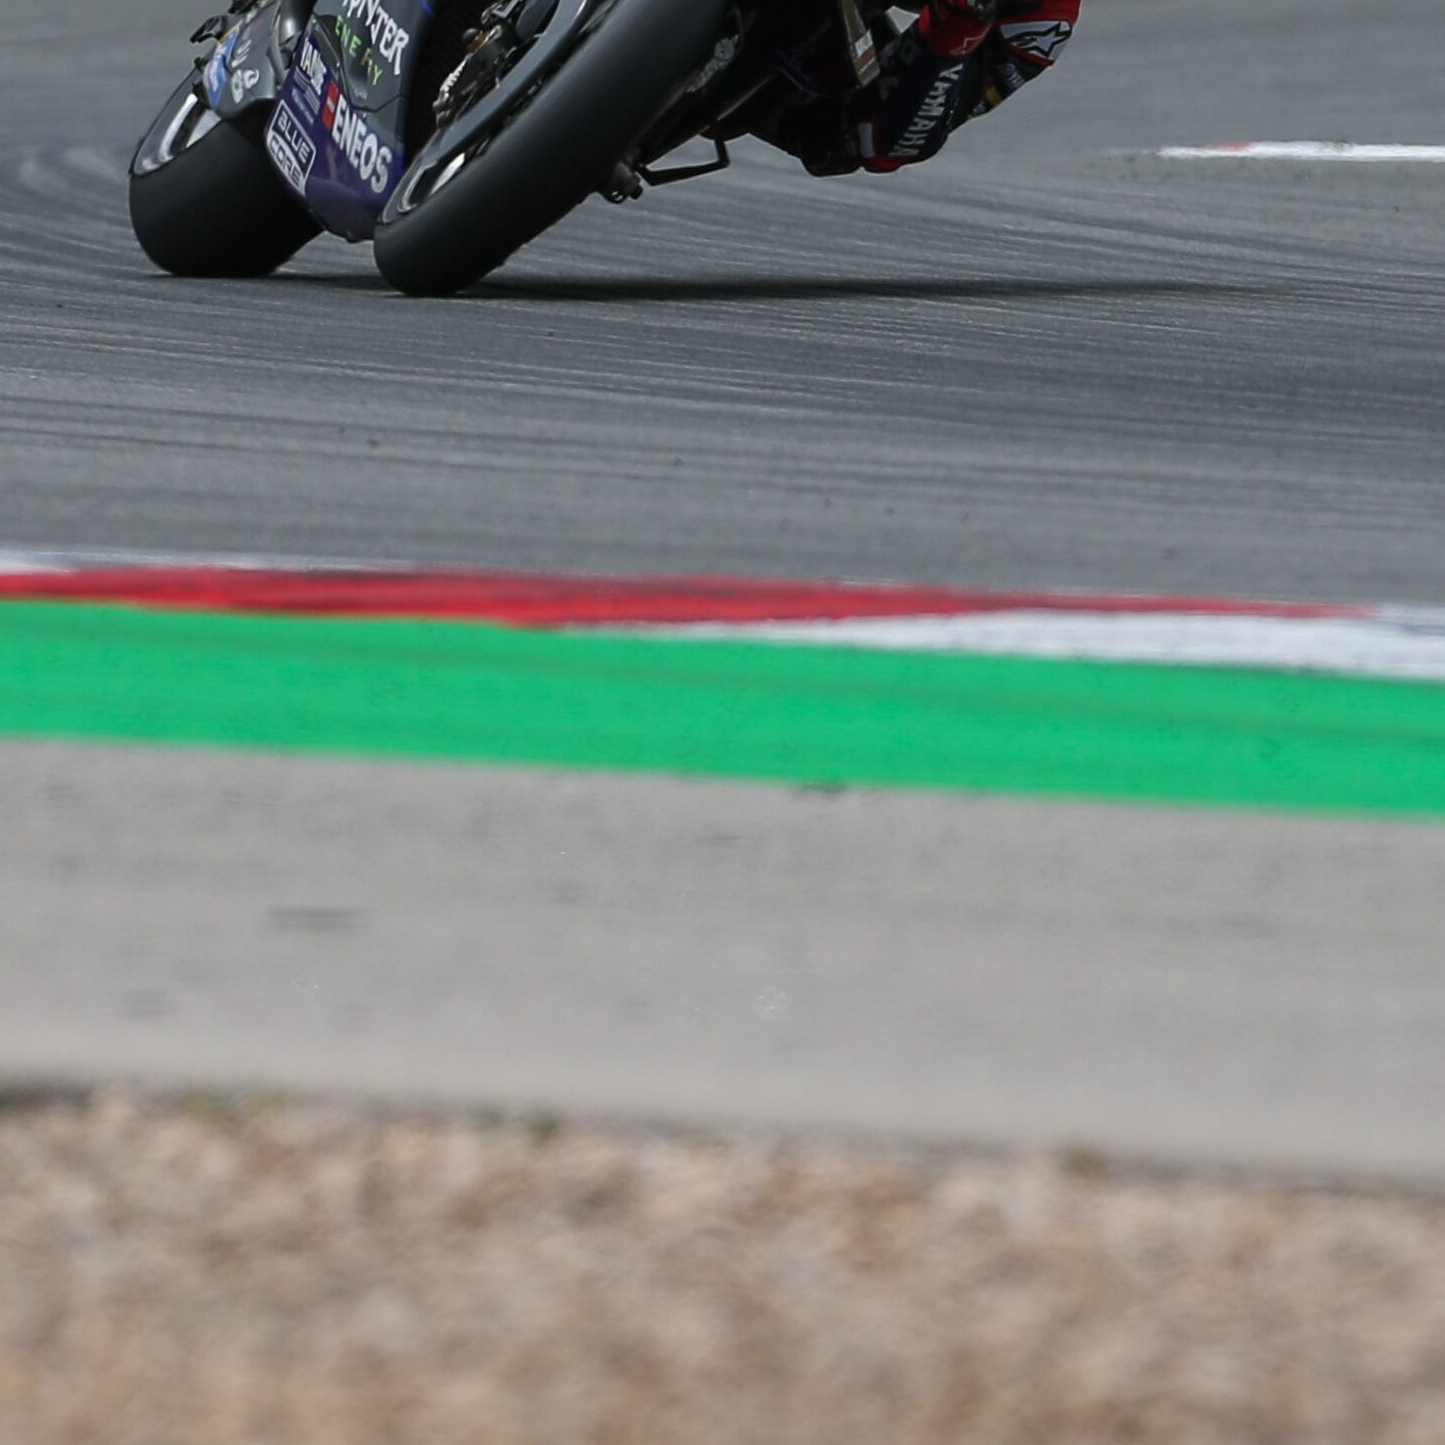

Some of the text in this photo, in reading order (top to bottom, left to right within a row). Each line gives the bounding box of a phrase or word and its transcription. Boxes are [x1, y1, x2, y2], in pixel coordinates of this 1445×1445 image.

[276, 108, 312, 164] BLUE
[331, 93, 393, 194] ENEOS
[888, 63, 963, 157] YAMAHA
[269, 132, 302, 188] CORE
